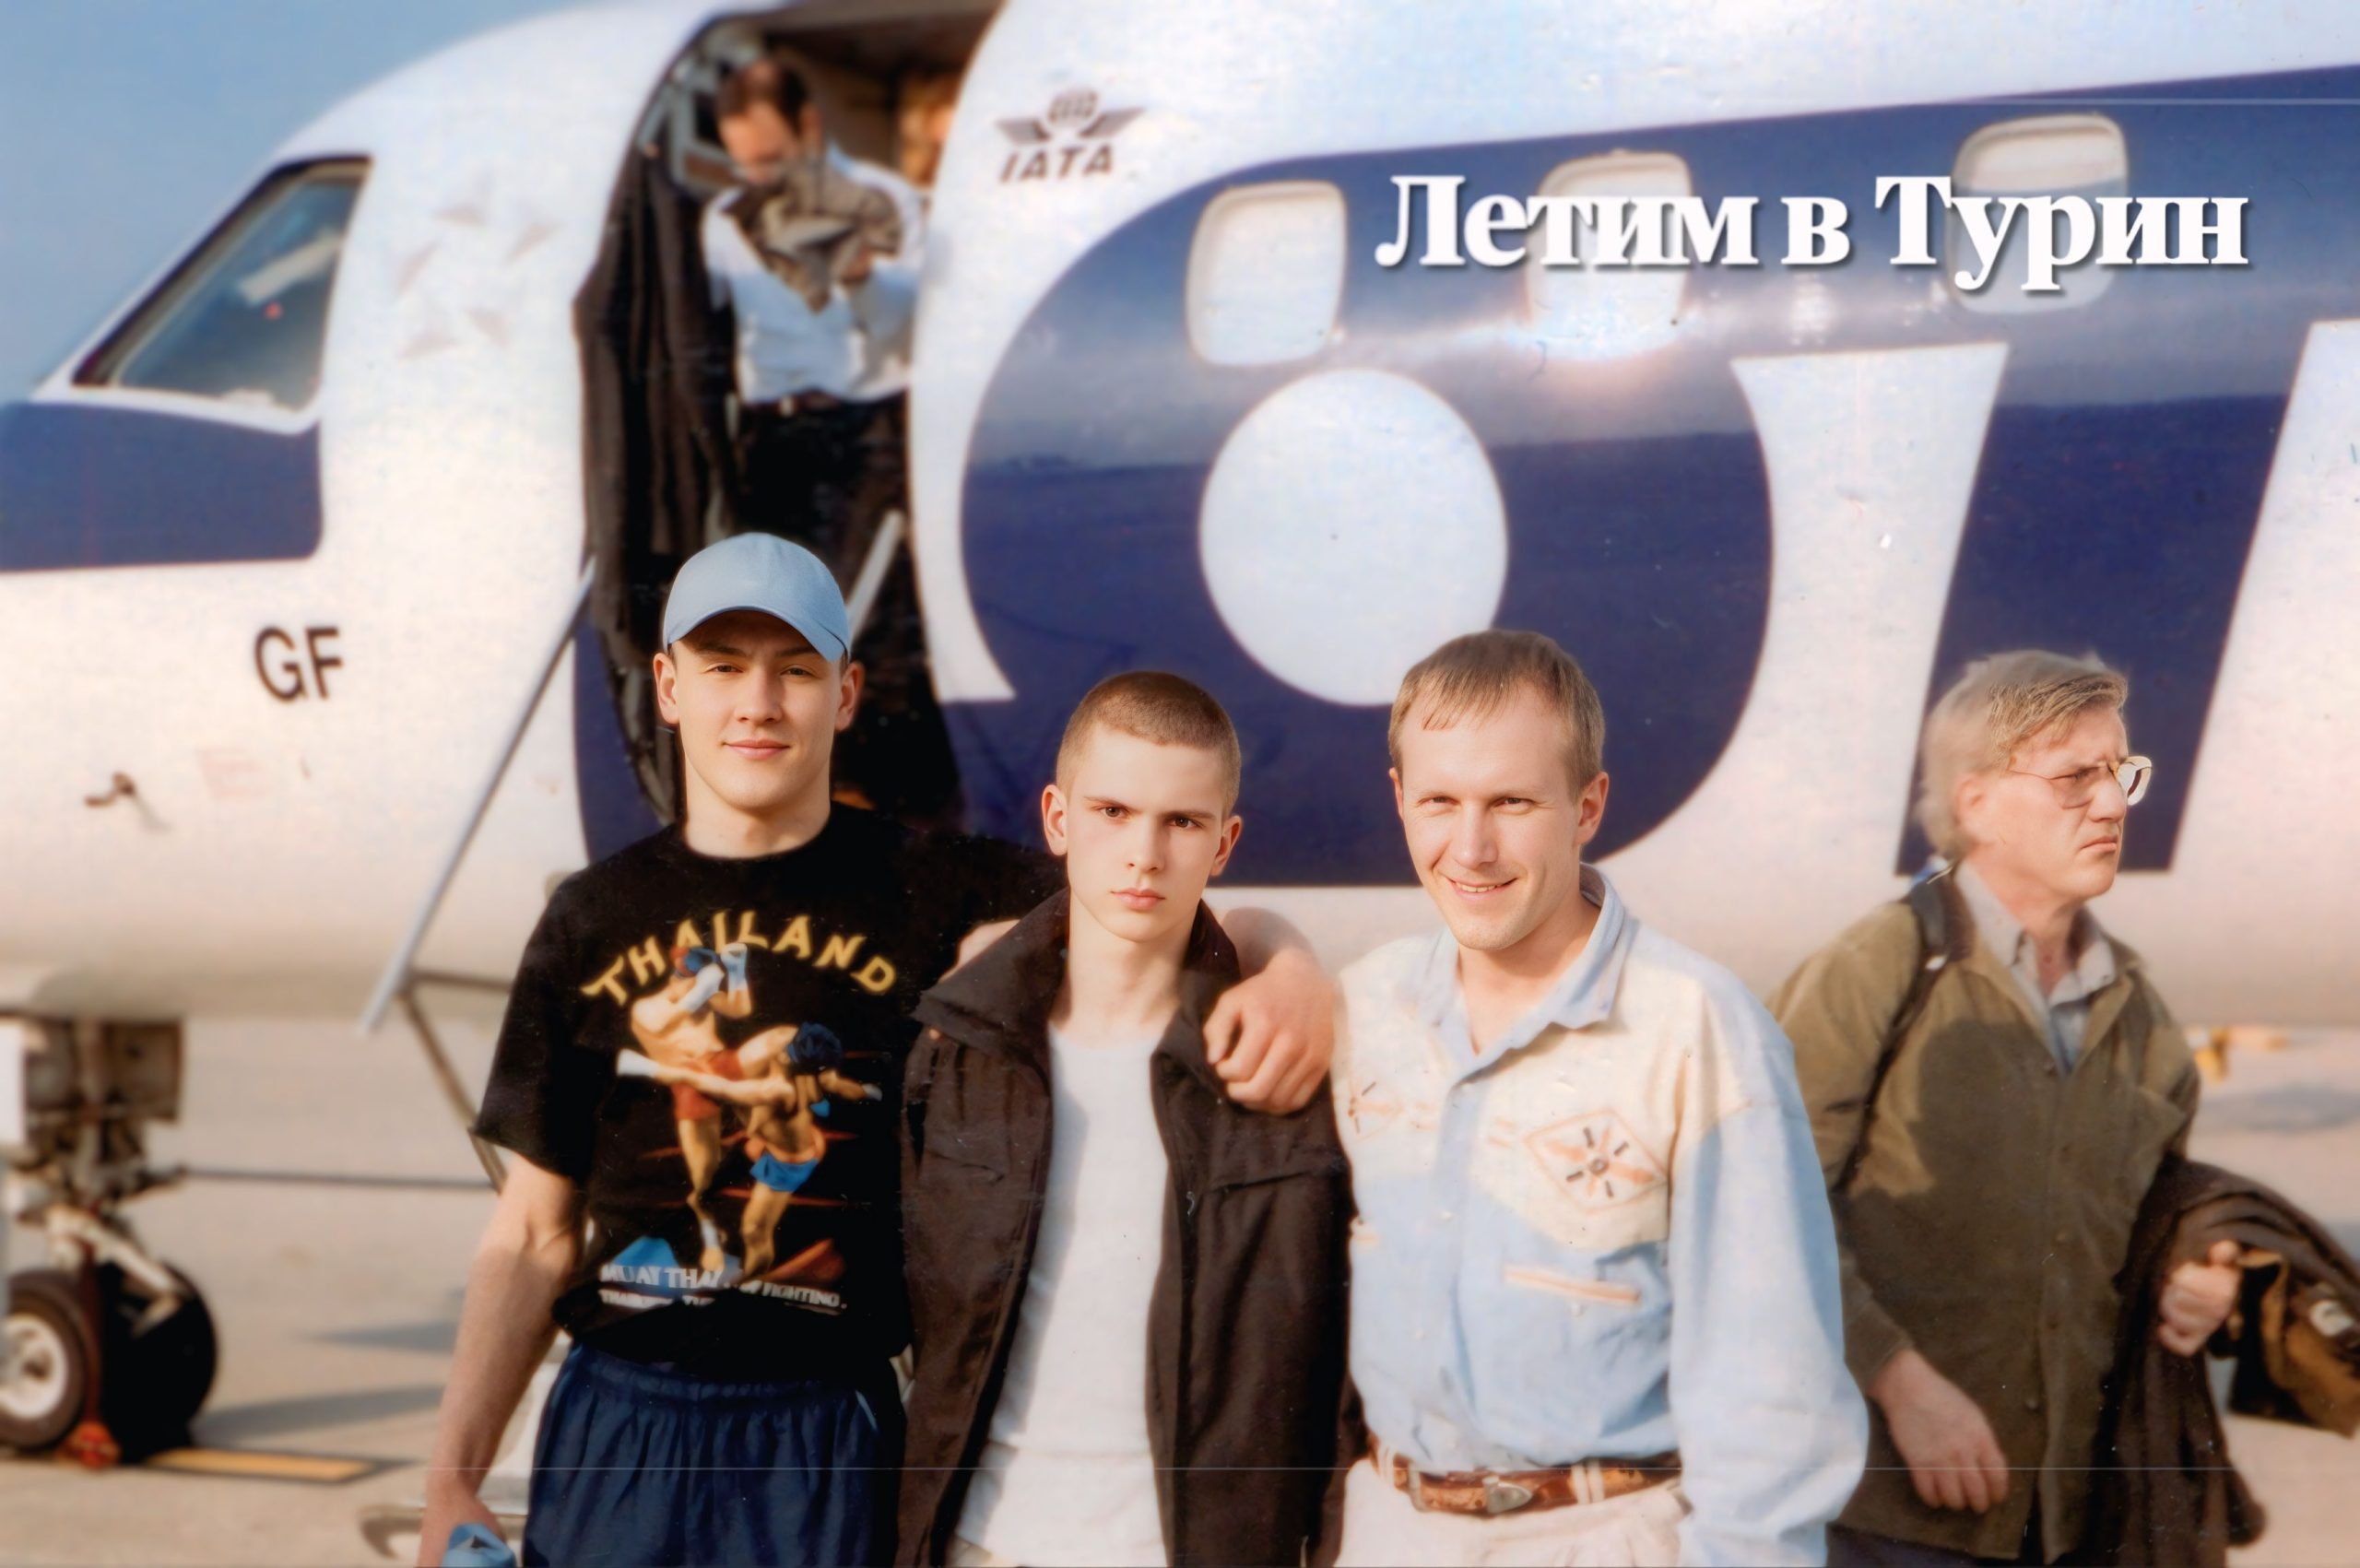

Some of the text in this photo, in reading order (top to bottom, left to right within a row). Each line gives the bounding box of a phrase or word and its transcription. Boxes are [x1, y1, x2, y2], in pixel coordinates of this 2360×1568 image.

[999, 143, 1114, 184] IATA
[254, 625, 344, 704] GF
[580, 909, 899, 1007] THAILAND
